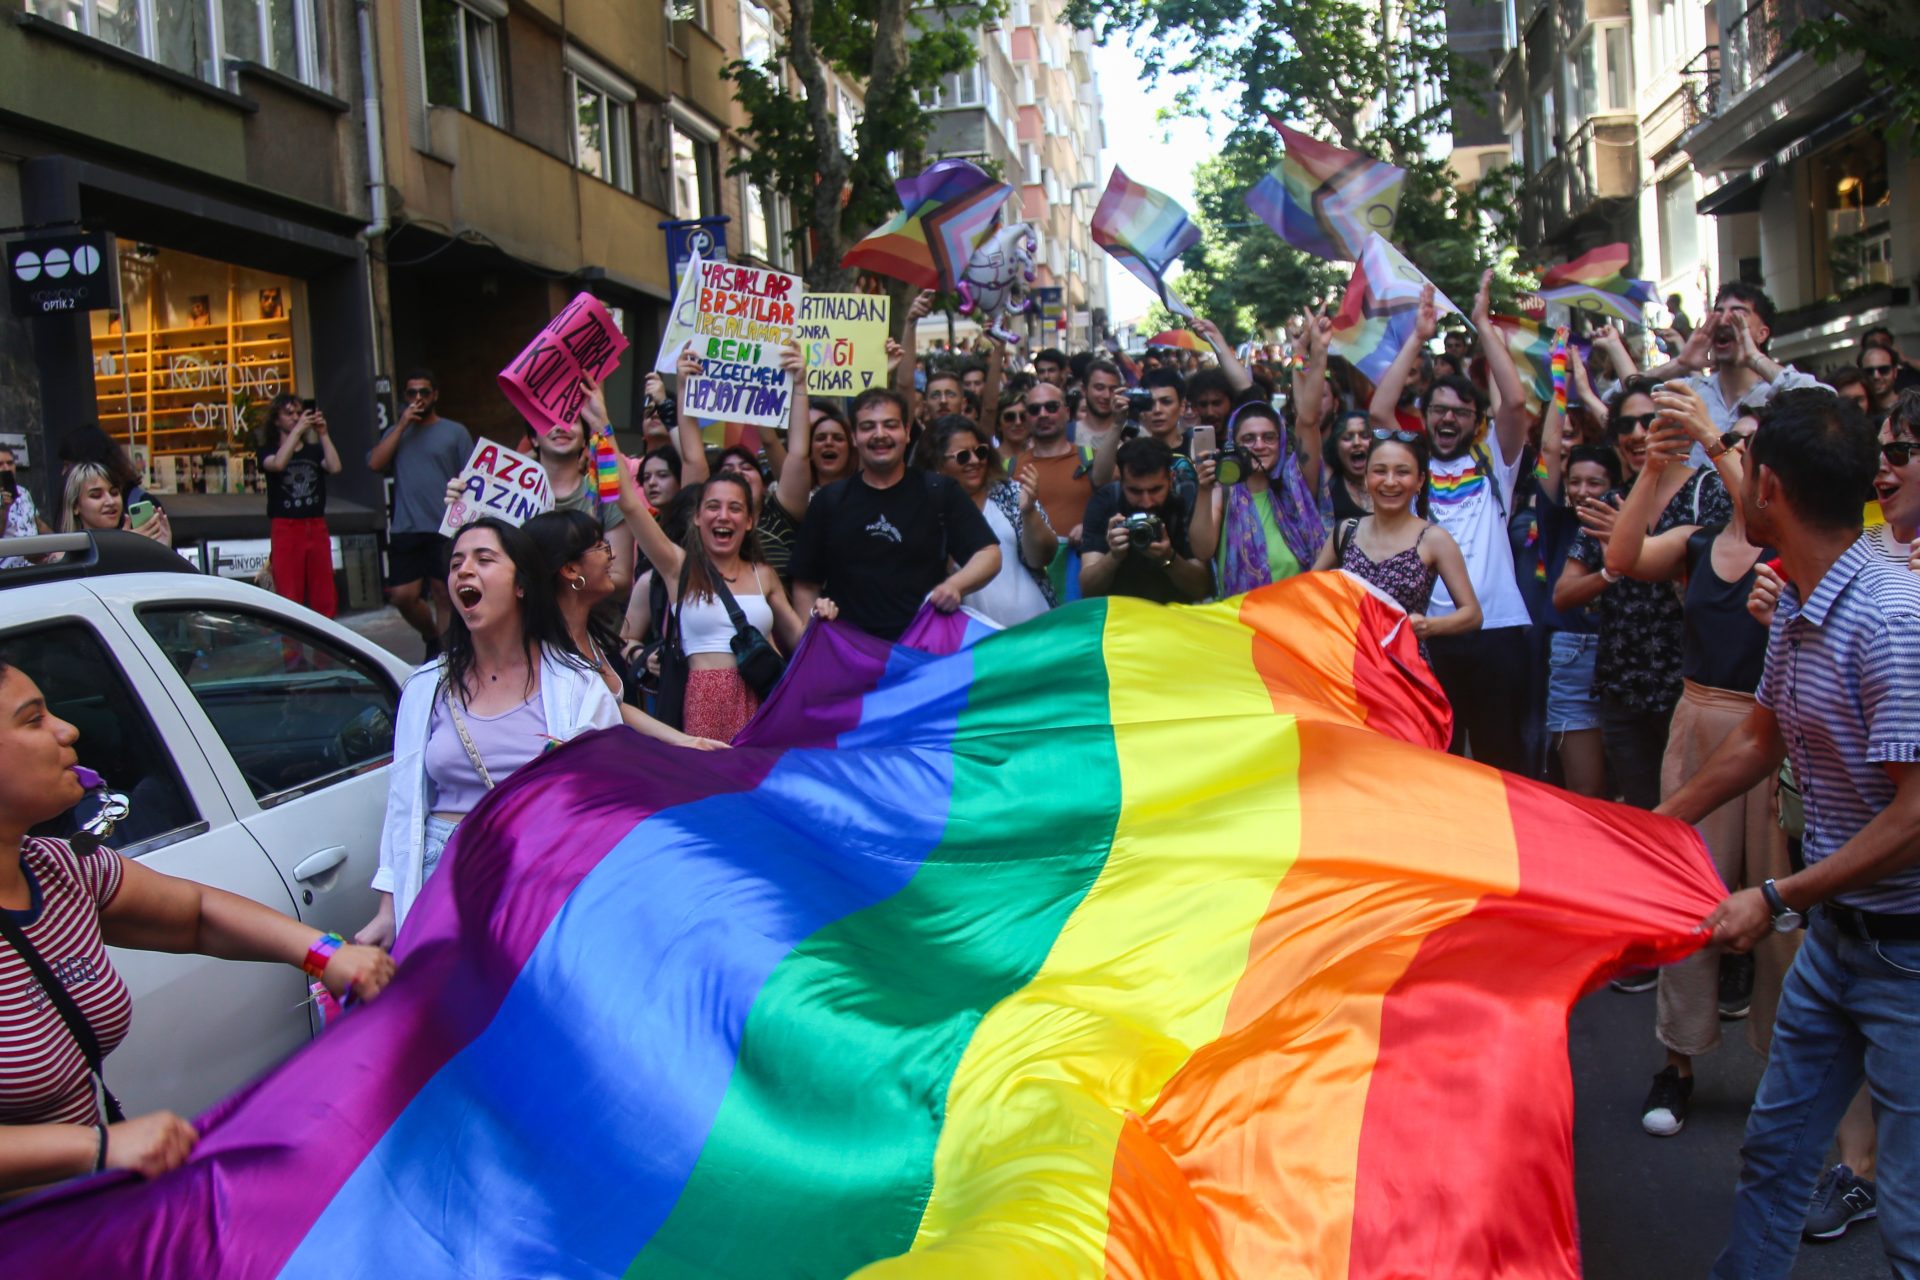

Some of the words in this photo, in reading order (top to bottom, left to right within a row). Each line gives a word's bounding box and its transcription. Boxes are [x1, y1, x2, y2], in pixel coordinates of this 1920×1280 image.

[702, 263, 793, 301] YASAKLAR
[69, 298, 75, 308] 2
[700, 288, 795, 326] BASKILAR
[799, 296, 886, 322] RTINADAN
[706, 337, 762, 364] BENİ
[168, 355, 281, 398] KOMONO
[807, 370, 853, 390] ÇIKAR
